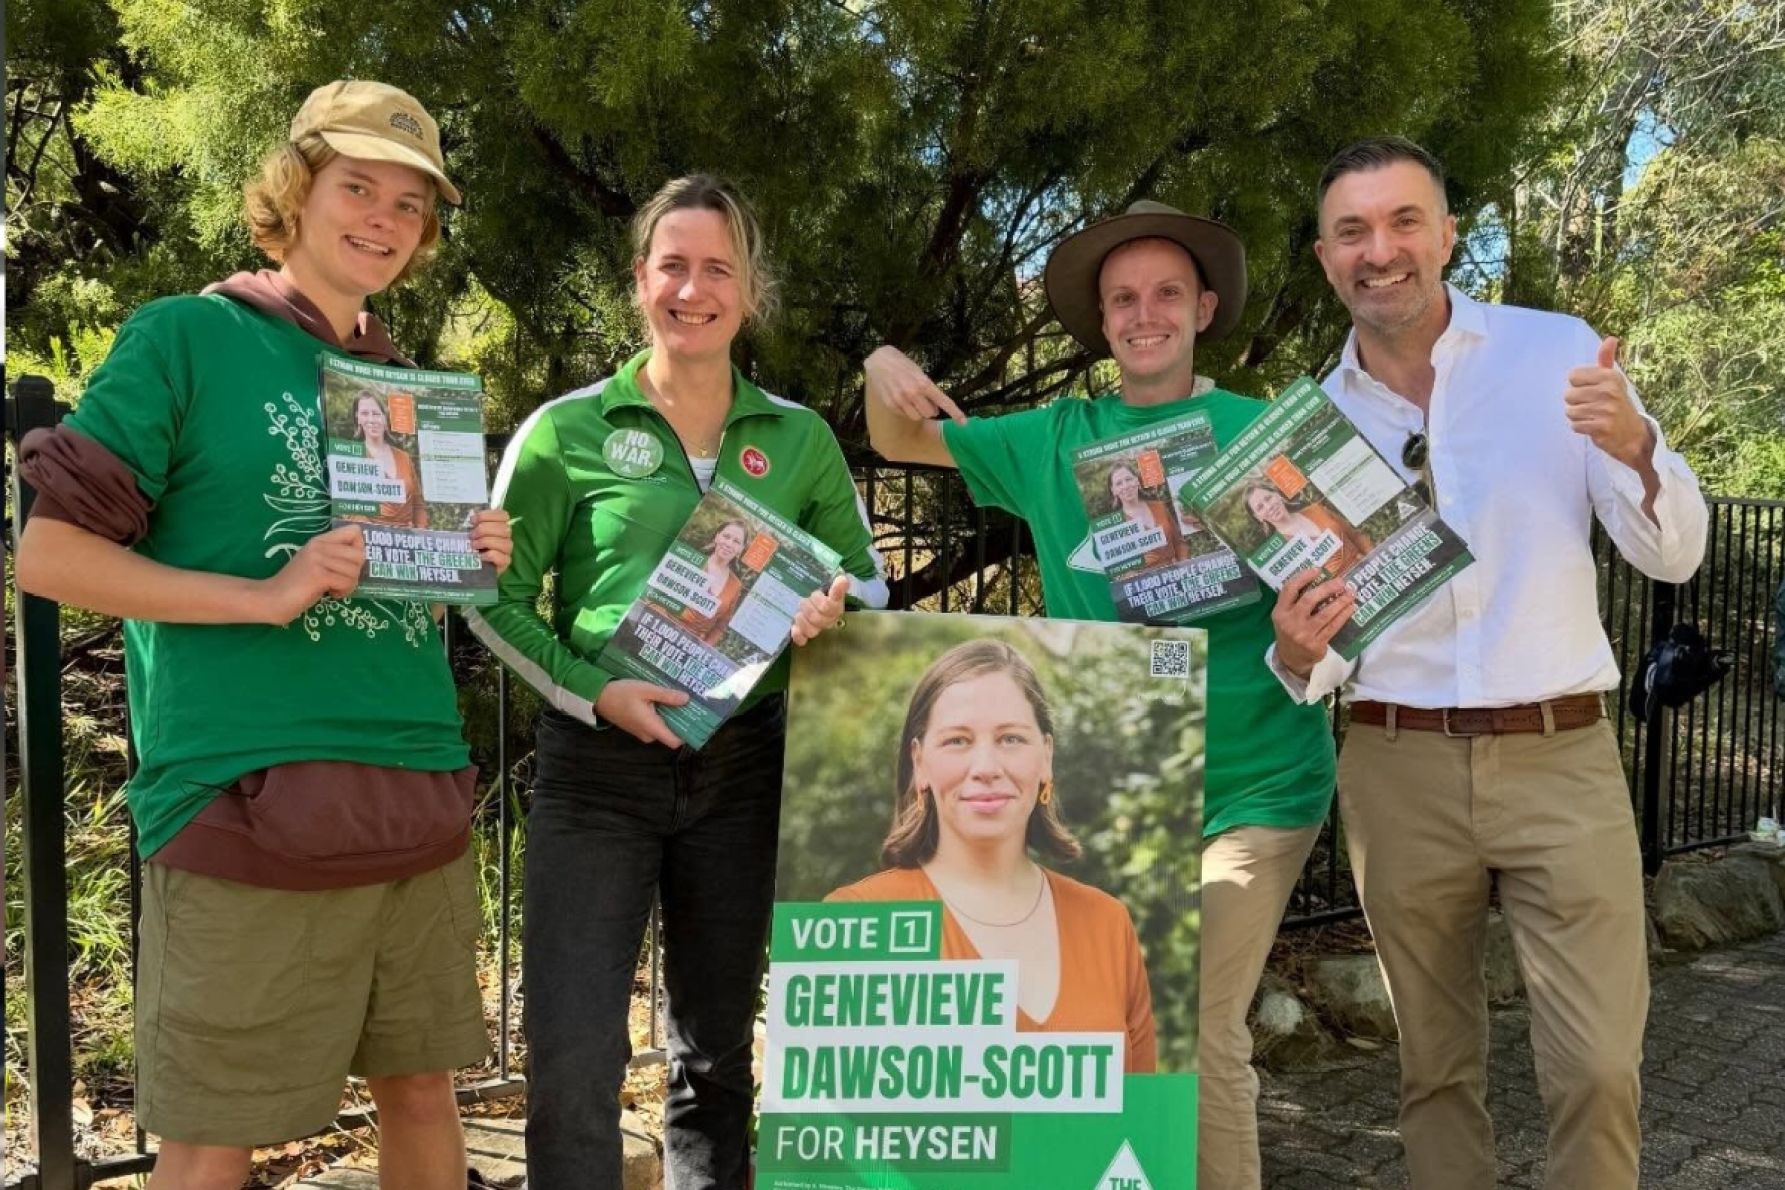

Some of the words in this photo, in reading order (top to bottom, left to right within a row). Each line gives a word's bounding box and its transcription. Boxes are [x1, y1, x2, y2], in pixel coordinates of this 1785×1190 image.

[611, 441, 653, 467] WAR.
[626, 430, 649, 449] NO
[395, 533, 434, 551] PEOPLE
[1353, 551, 1390, 587] PEOPLE
[1388, 521, 1430, 558] CHANGE
[1401, 532, 1441, 568] GREENS
[1161, 564, 1197, 585] PEOPLE
[1354, 603, 1377, 626] CAN
[1375, 584, 1399, 610] WIN
[634, 624, 662, 648] THEIR
[640, 612, 653, 626] IF
[677, 636, 712, 664] PEOPLE
[791, 917, 879, 949] VOTE
[903, 919, 917, 945] 1
[784, 972, 1004, 1028] GENEVIEVE
[782, 1044, 1114, 1100] DAWSON-SCOTT
[776, 1125, 845, 1161] FOR
[854, 1125, 998, 1160] HEYSEN
[1109, 1177, 1142, 1190] THE
